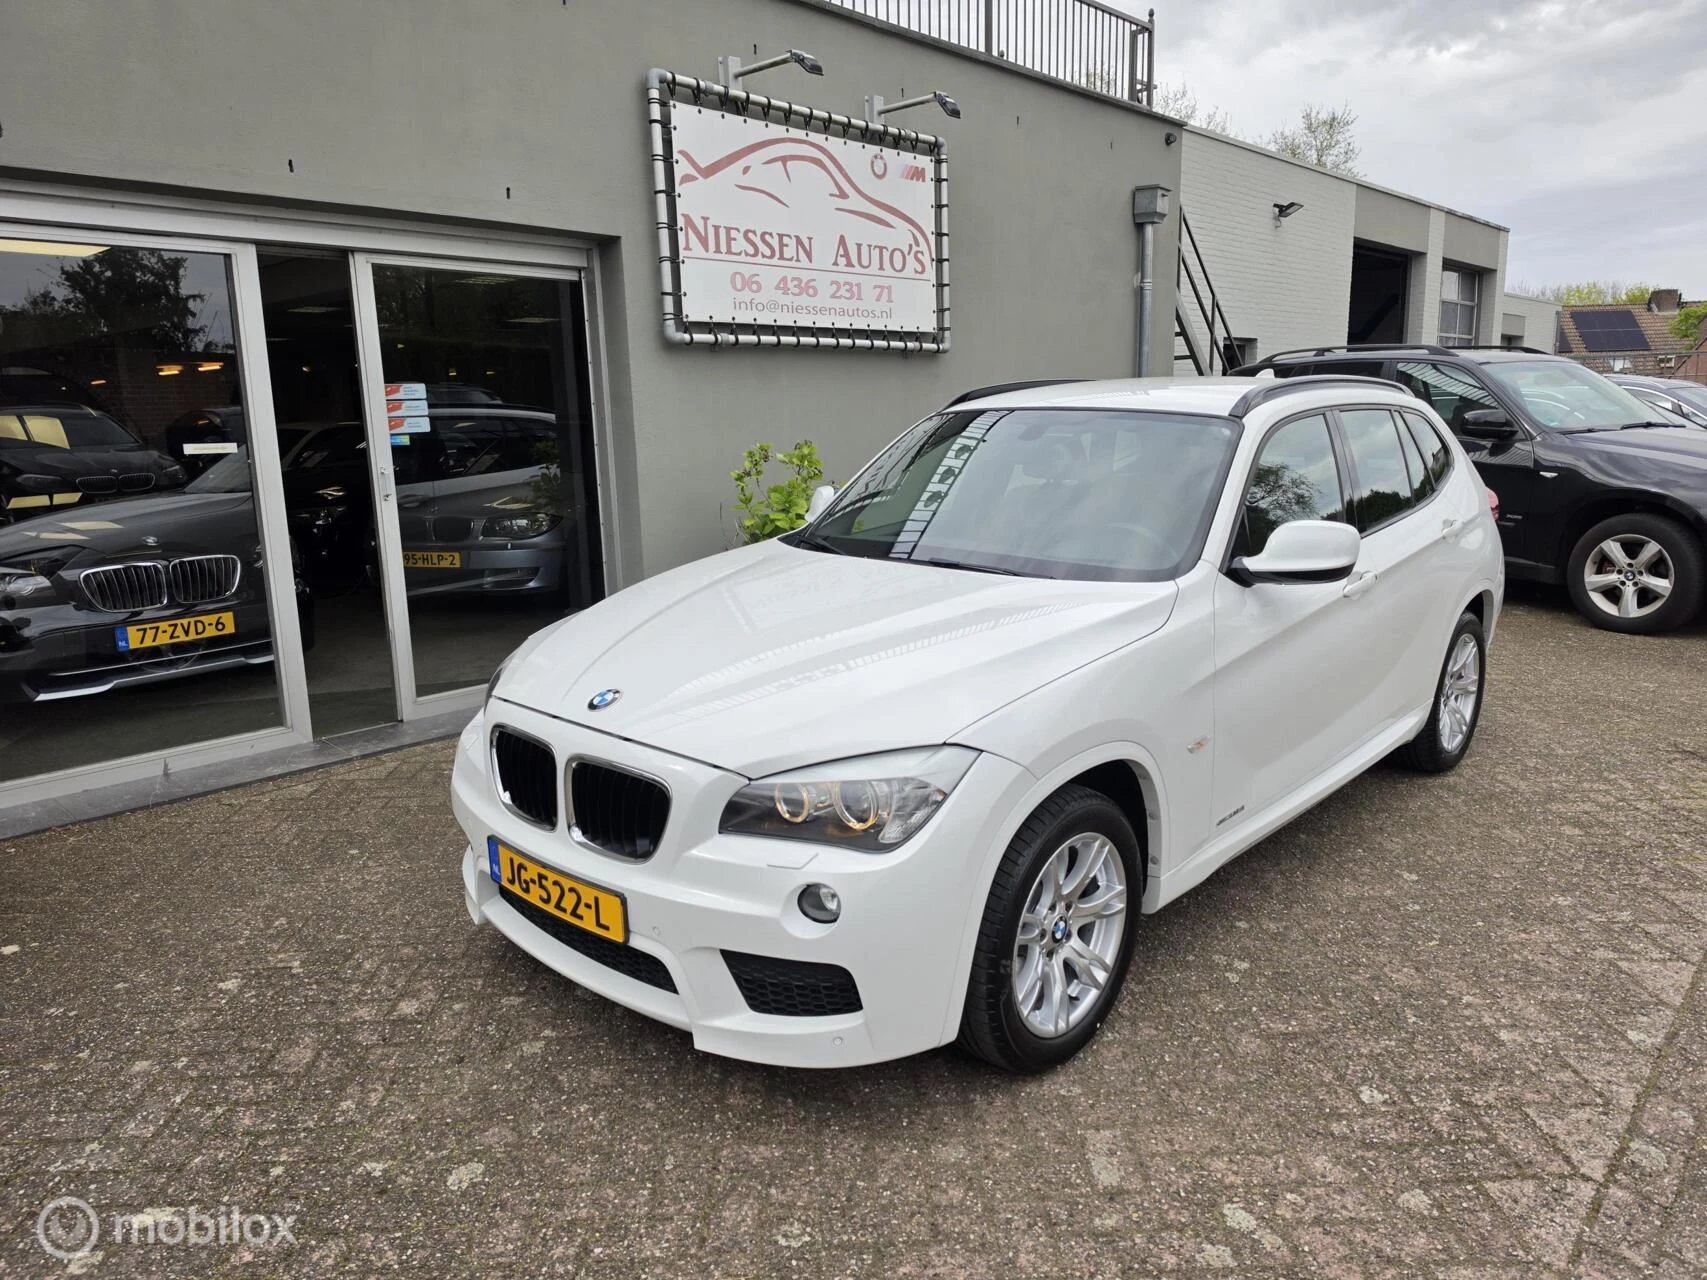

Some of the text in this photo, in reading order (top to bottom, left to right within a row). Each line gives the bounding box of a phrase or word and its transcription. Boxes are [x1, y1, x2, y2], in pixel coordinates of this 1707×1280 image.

[681, 213, 926, 274] NIESSEN AUTO'S
[730, 271, 894, 304] 06 436 231 71
[732, 298, 893, 319] info@niessenautos.nl
[404, 553, 457, 566] 95-HLP-2
[136, 616, 226, 645] 77-ZVD-6
[507, 857, 610, 931] JG-522-L
